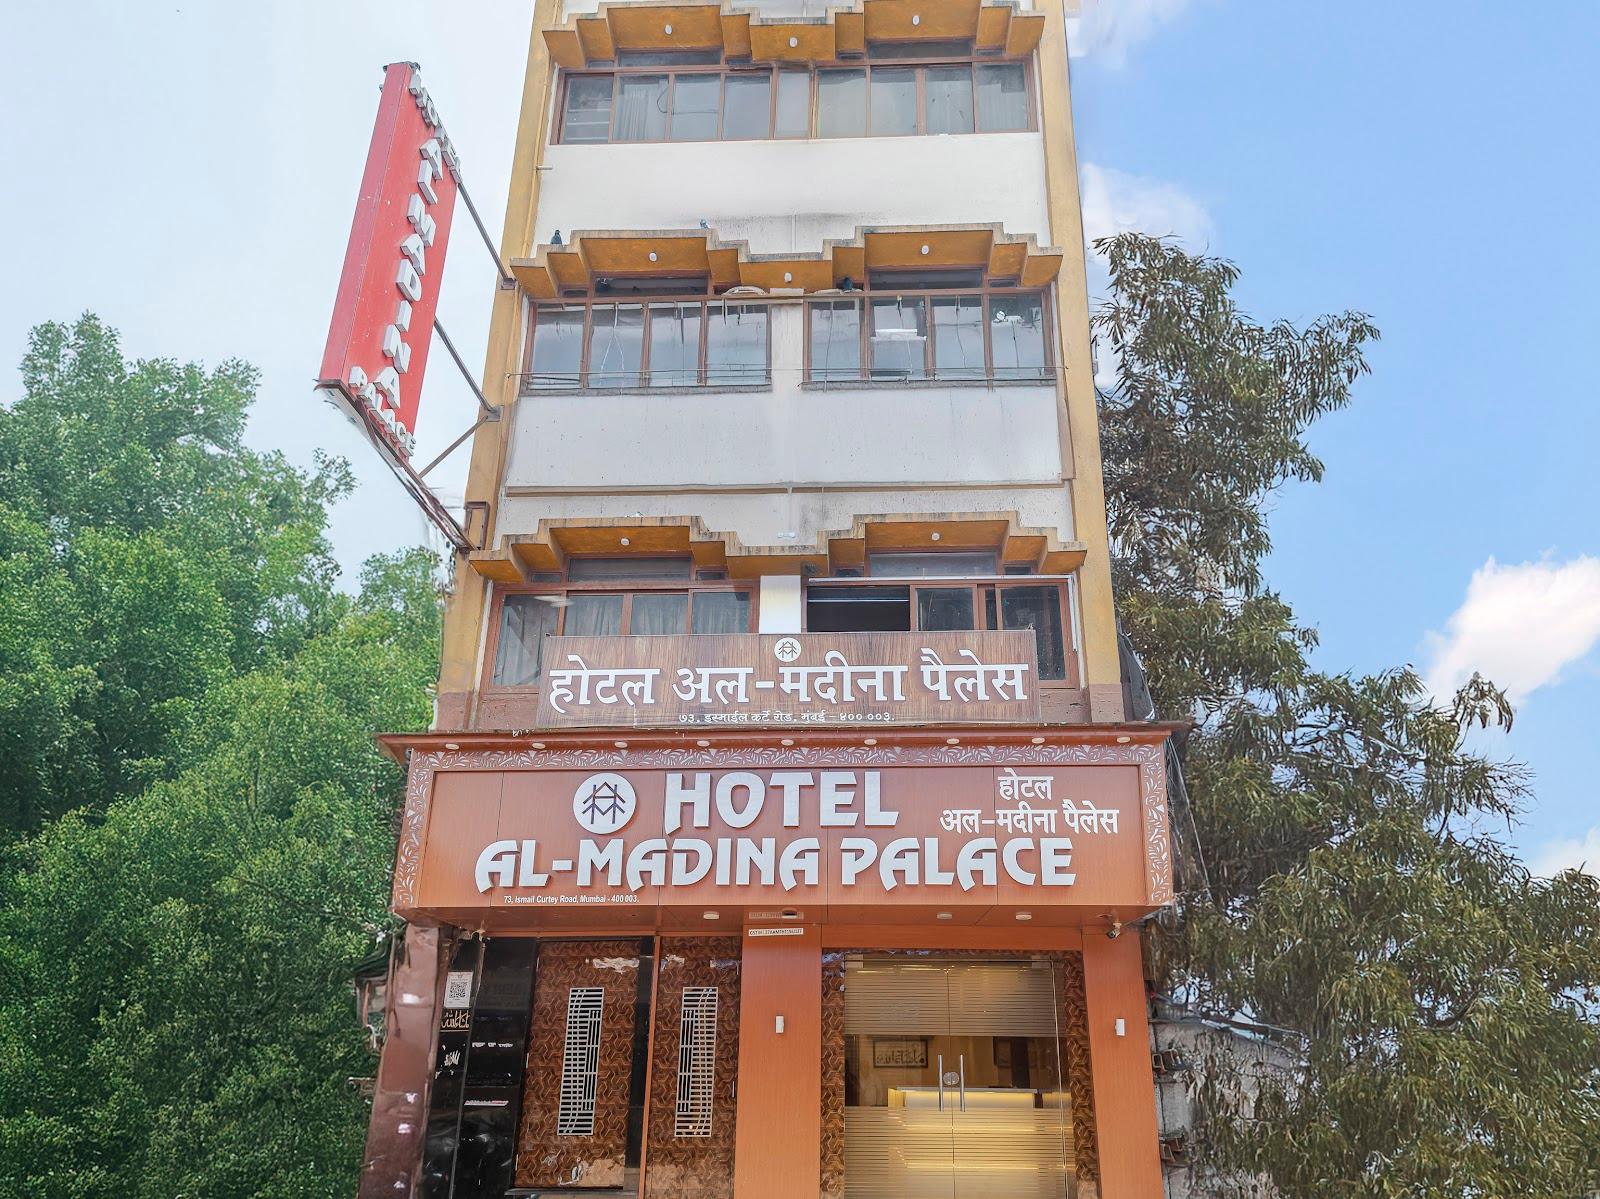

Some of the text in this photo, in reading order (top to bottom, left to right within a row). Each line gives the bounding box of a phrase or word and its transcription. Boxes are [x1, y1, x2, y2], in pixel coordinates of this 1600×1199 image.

[348, 366, 416, 457] PALACE
[549, 654, 660, 714] होटल
[920, 647, 1029, 703] पैलेस
[665, 771, 899, 835] HOTEL
[997, 767, 1054, 801] होटल
[939, 798, 1120, 834] अल-मदीना पैलेस
[474, 837, 1076, 893] AL-MADINA PALACE
[580, 894, 606, 904] Mumbai
